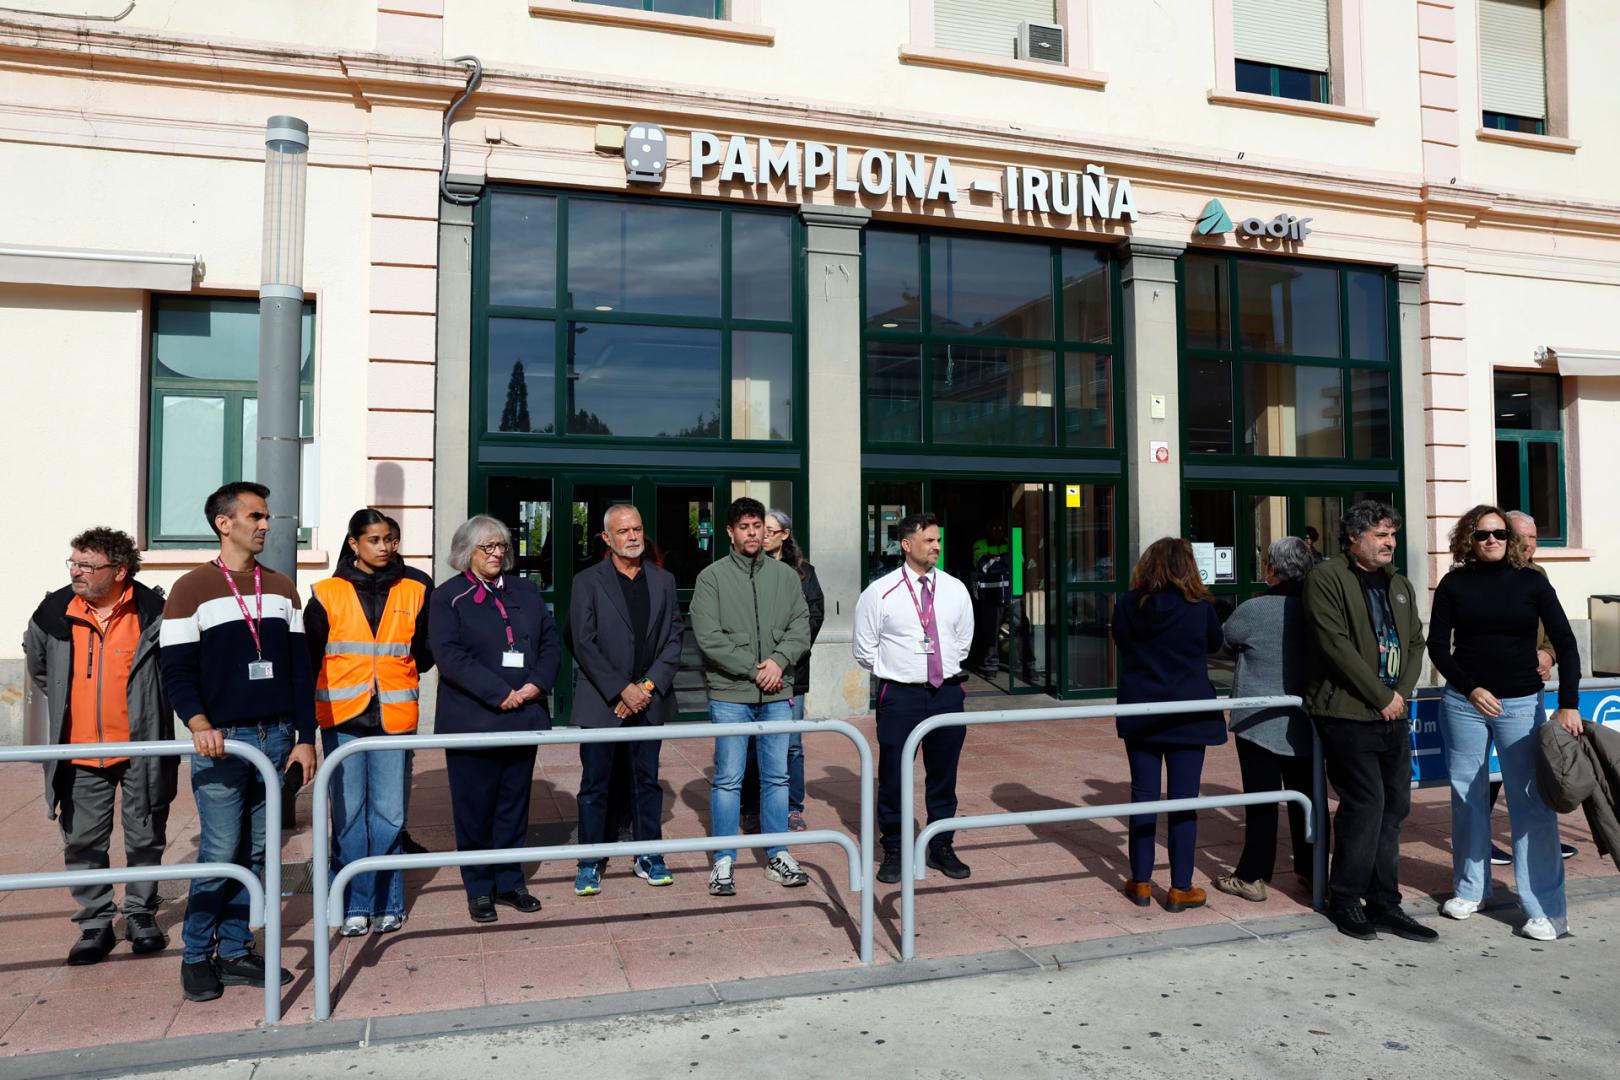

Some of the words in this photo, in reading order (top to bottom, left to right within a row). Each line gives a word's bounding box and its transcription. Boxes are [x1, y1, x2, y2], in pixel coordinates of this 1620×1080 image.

[690, 131, 958, 204] PAMPLONA
[1004, 163, 1138, 223] IRUÑA
[1242, 213, 1313, 241] adif
